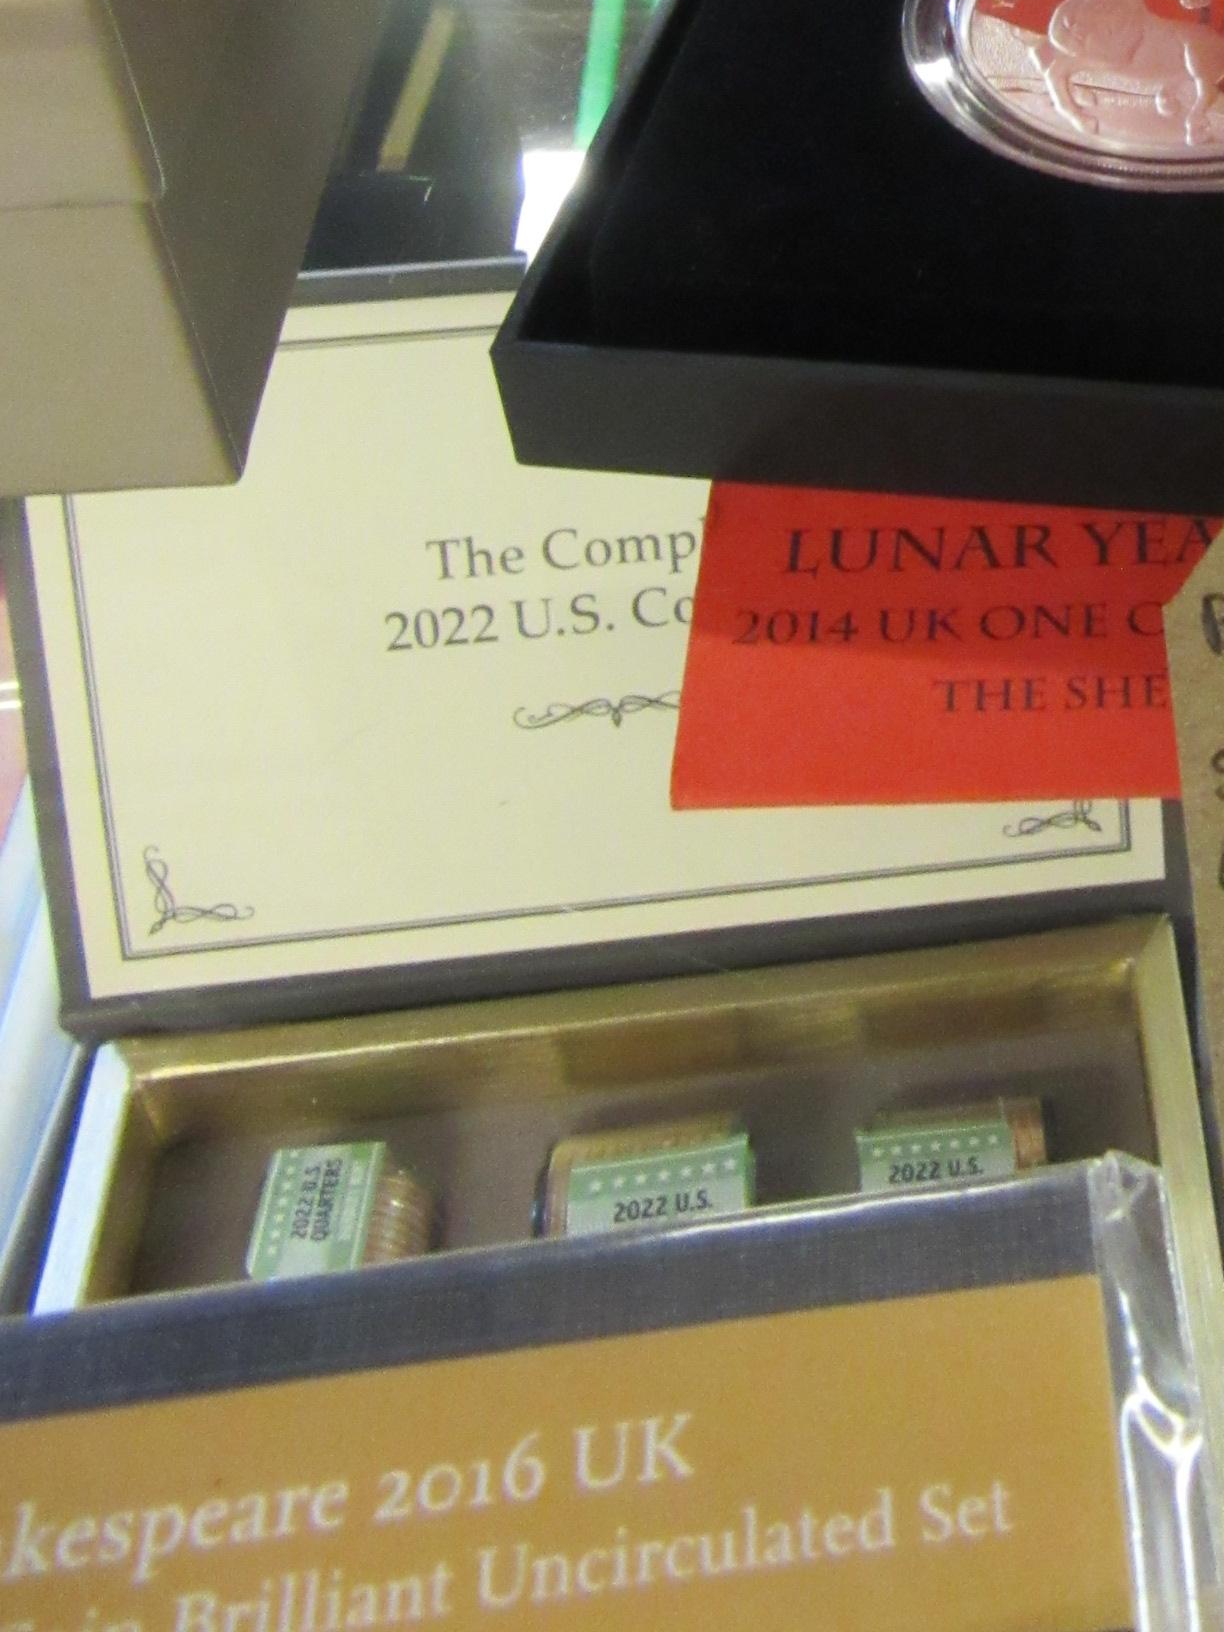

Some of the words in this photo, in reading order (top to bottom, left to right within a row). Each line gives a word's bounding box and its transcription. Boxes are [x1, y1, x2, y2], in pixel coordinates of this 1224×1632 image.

[425, 535, 524, 581] The
[541, 527, 699, 574] Comp
[783, 524, 1058, 578] LUNAR
[384, 603, 499, 652] 2022
[511, 592, 616, 640] U.S.
[731, 607, 859, 645] 2014
[877, 605, 963, 642] UK
[979, 603, 1108, 641] ONE
[932, 677, 1047, 712] THE
[887, 1159, 940, 1185] 2022
[612, 1194, 666, 1224] 2022
[674, 1189, 714, 1215] U.S.
[0, 1479, 350, 1586] kespeare
[372, 1430, 547, 1524] 2016
[574, 1411, 696, 1490] UK
[476, 1485, 896, 1611] Uncirculated
[918, 1478, 1015, 1544] Set
